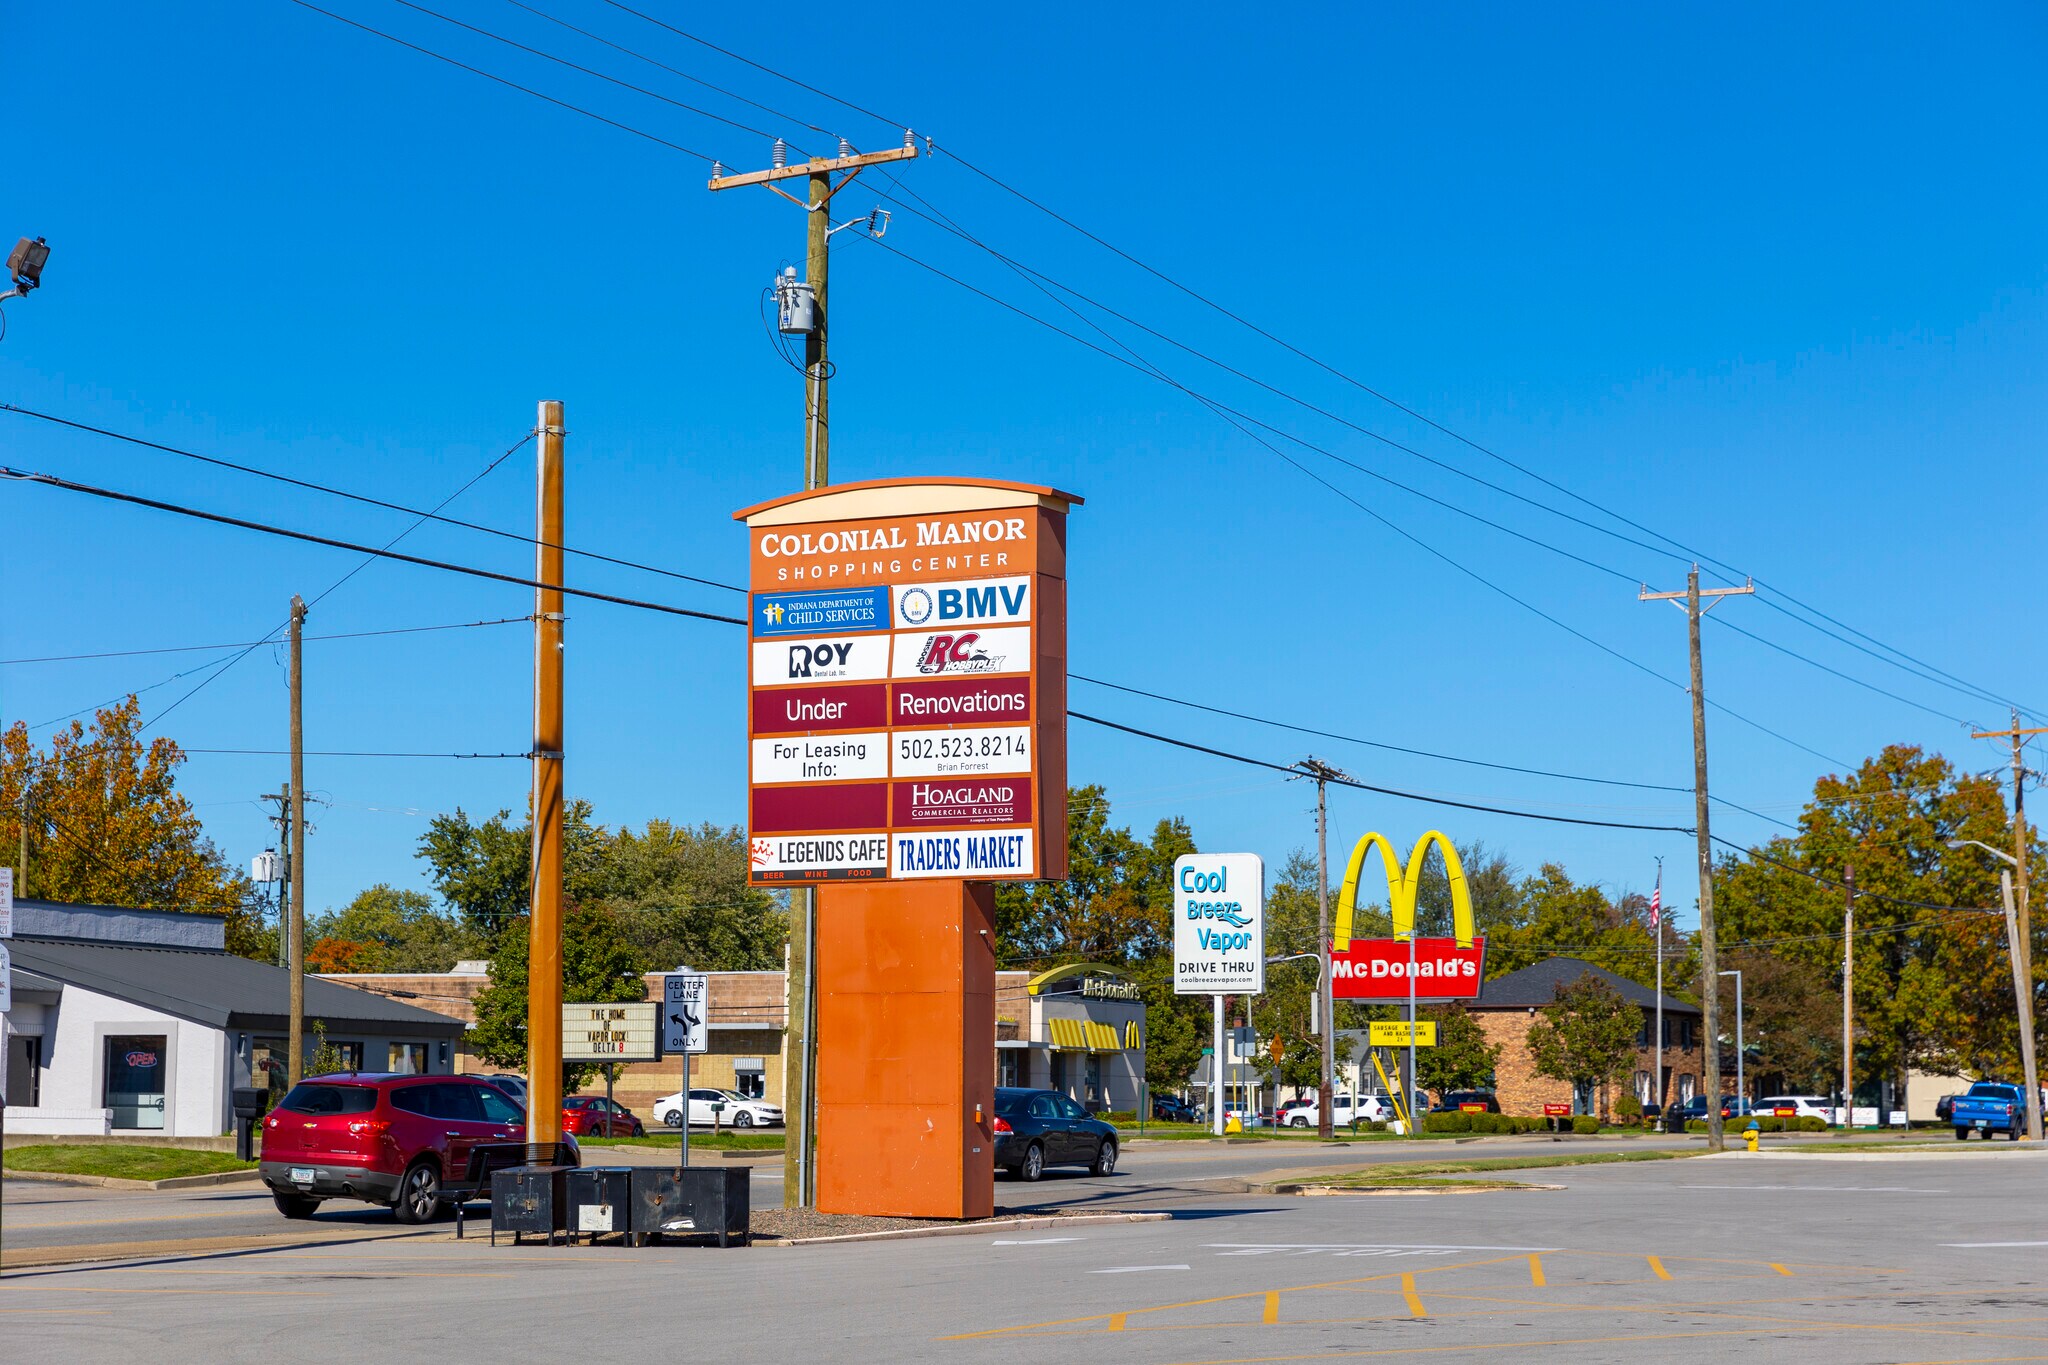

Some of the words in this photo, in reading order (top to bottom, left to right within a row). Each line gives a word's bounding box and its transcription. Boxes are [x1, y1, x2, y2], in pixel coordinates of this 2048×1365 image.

[761, 527, 907, 558] COLONIAL
[916, 518, 1026, 547] MANOR
[778, 559, 901, 581] SHOPPING
[912, 552, 1009, 572] CENTER
[788, 601, 817, 611] INDIANA
[818, 598, 864, 609] DEPARTMENT
[864, 597, 874, 606] OF
[938, 584, 1027, 620] BMV
[788, 611, 824, 625] CHILD
[825, 608, 875, 622] SERVICES
[788, 642, 854, 679] ROY
[787, 698, 847, 722] Under
[900, 690, 1026, 716] Renovations
[773, 744, 800, 759] For
[805, 741, 867, 760] Leasing
[901, 735, 1026, 760] 502.523.8214
[802, 761, 838, 777] Info:
[937, 762, 958, 772] Brian
[960, 761, 989, 772] Forrest
[912, 784, 1014, 806] HOAGLAND
[911, 808, 967, 817] COMMERCIAL
[972, 807, 1014, 815] REALTORS
[778, 839, 845, 864] LEGENDS
[848, 838, 886, 862] CAFE
[898, 838, 961, 872] TRADERS
[966, 835, 1024, 870] MARKET
[763, 872, 785, 880] BEER
[804, 870, 829, 878] WINE
[847, 868, 872, 877] FOOD
[1180, 865, 1227, 893] Cool
[1187, 899, 1242, 920] Breeze
[1197, 927, 1253, 955] Vapor
[1179, 962, 1216, 973] DRIVE
[1221, 962, 1255, 973] THRU
[1332, 958, 1477, 979] McDonald's
[668, 981, 704, 990] CENTER
[1180, 976, 1253, 984] coolbreezevapor.com
[673, 990, 699, 999] LANE
[1083, 978, 1141, 1001] McDonald's
[591, 1009, 605, 1020] THE
[608, 1009, 626, 1020] HOME
[603, 1020, 612, 1031] OF
[587, 1031, 609, 1042] VAPOR
[672, 1038, 698, 1047] ONLY
[593, 1042, 616, 1053] DELTA
[127, 1052, 155, 1067] OPEN
